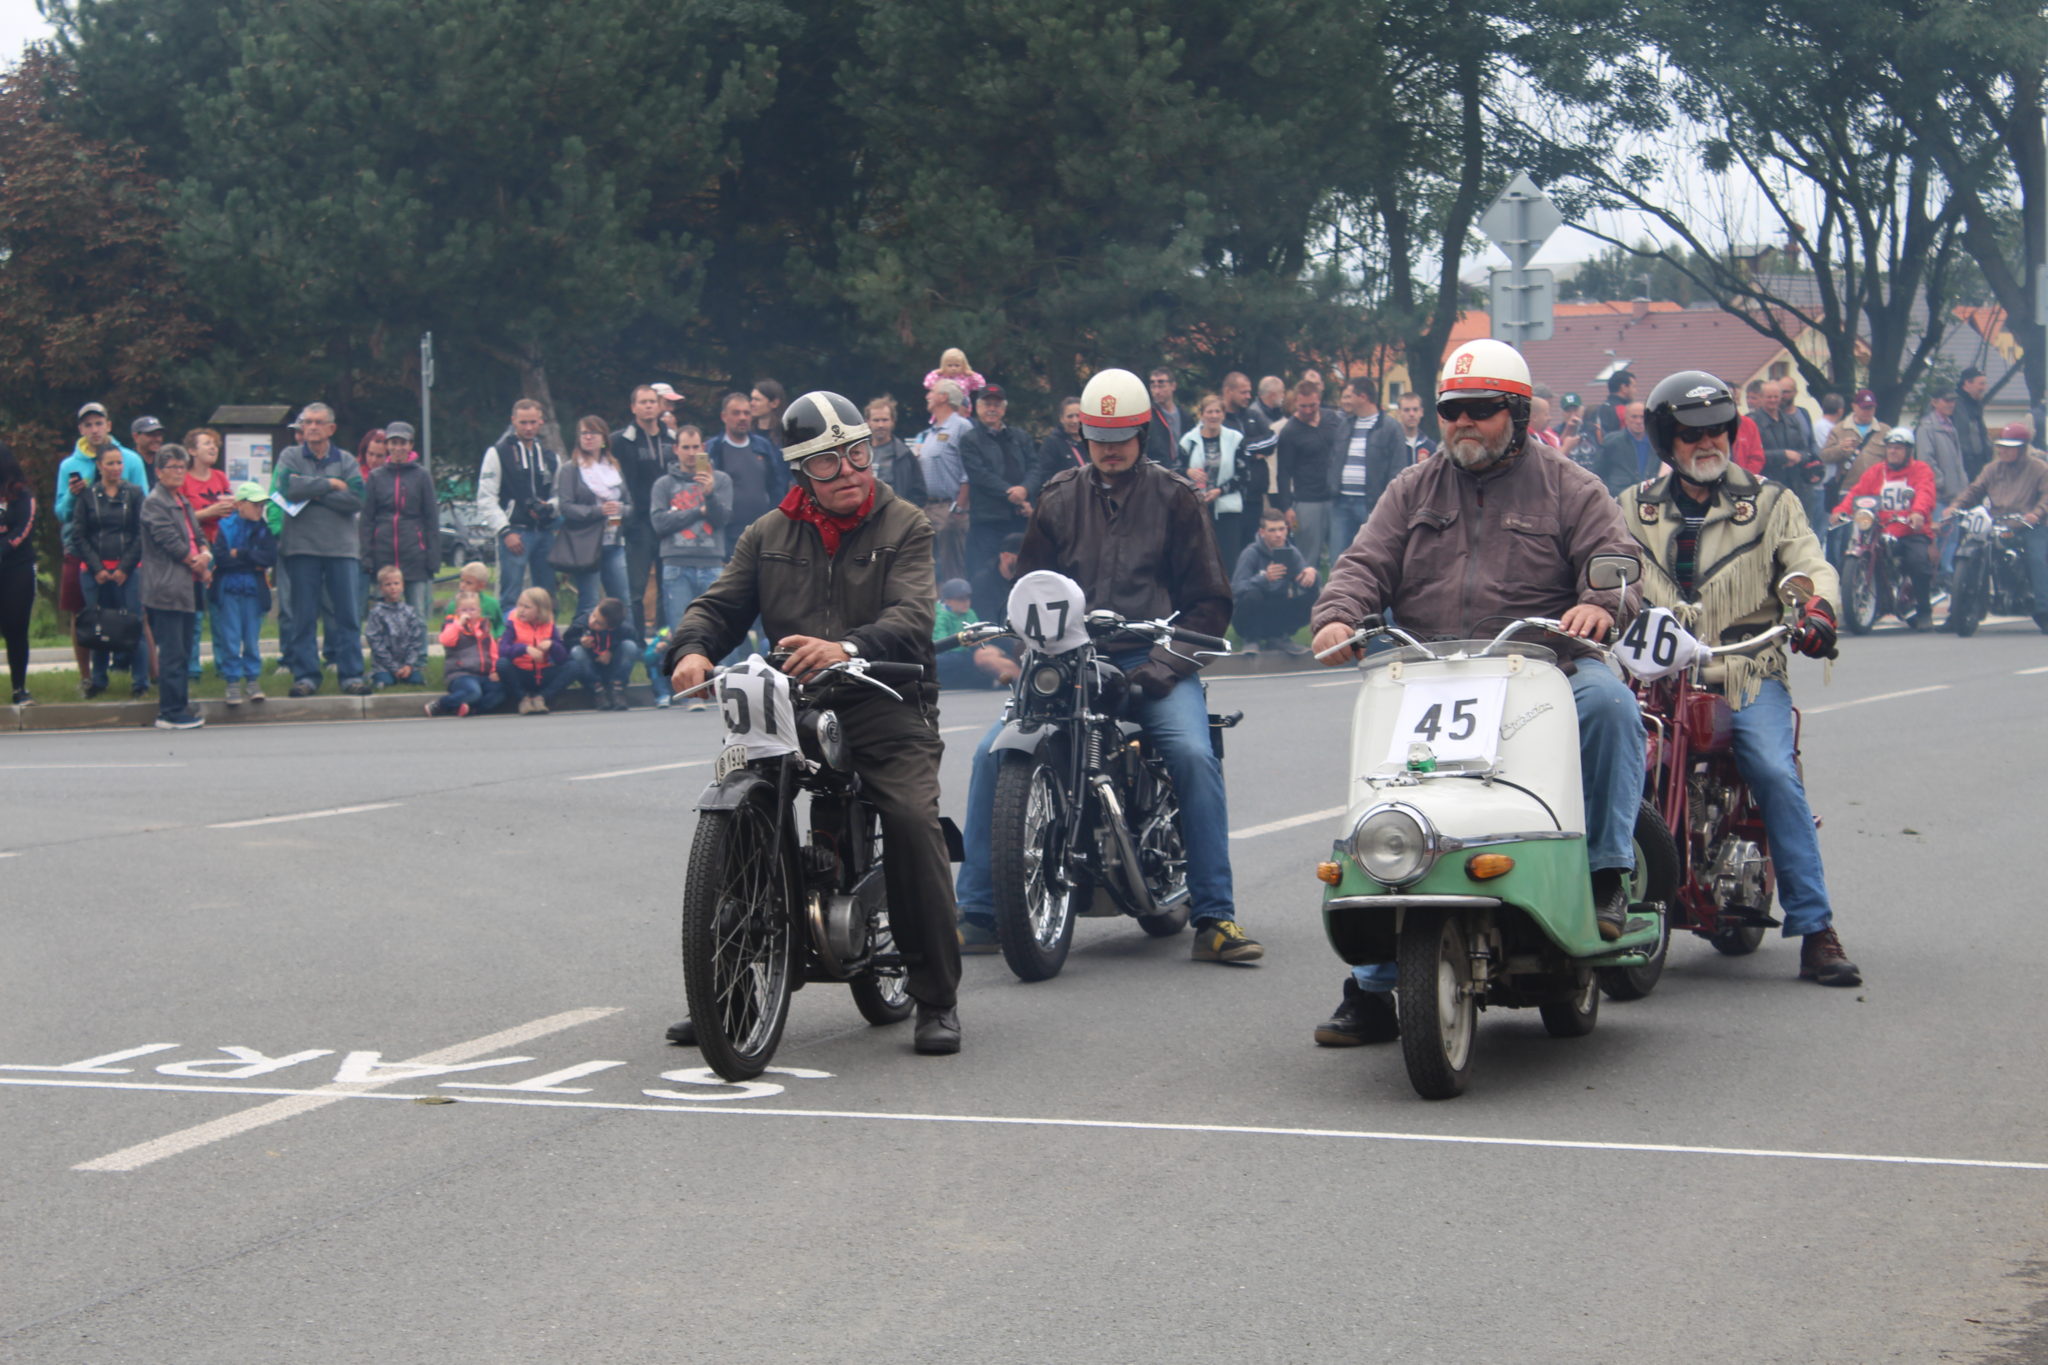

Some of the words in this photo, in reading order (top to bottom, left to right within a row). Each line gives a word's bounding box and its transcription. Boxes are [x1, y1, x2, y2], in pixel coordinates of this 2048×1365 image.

[1024, 600, 1069, 648] 47
[1623, 609, 1682, 667] 46
[720, 664, 777, 735] 51
[1414, 698, 1478, 742] 45
[0, 1042, 837, 1101] START
